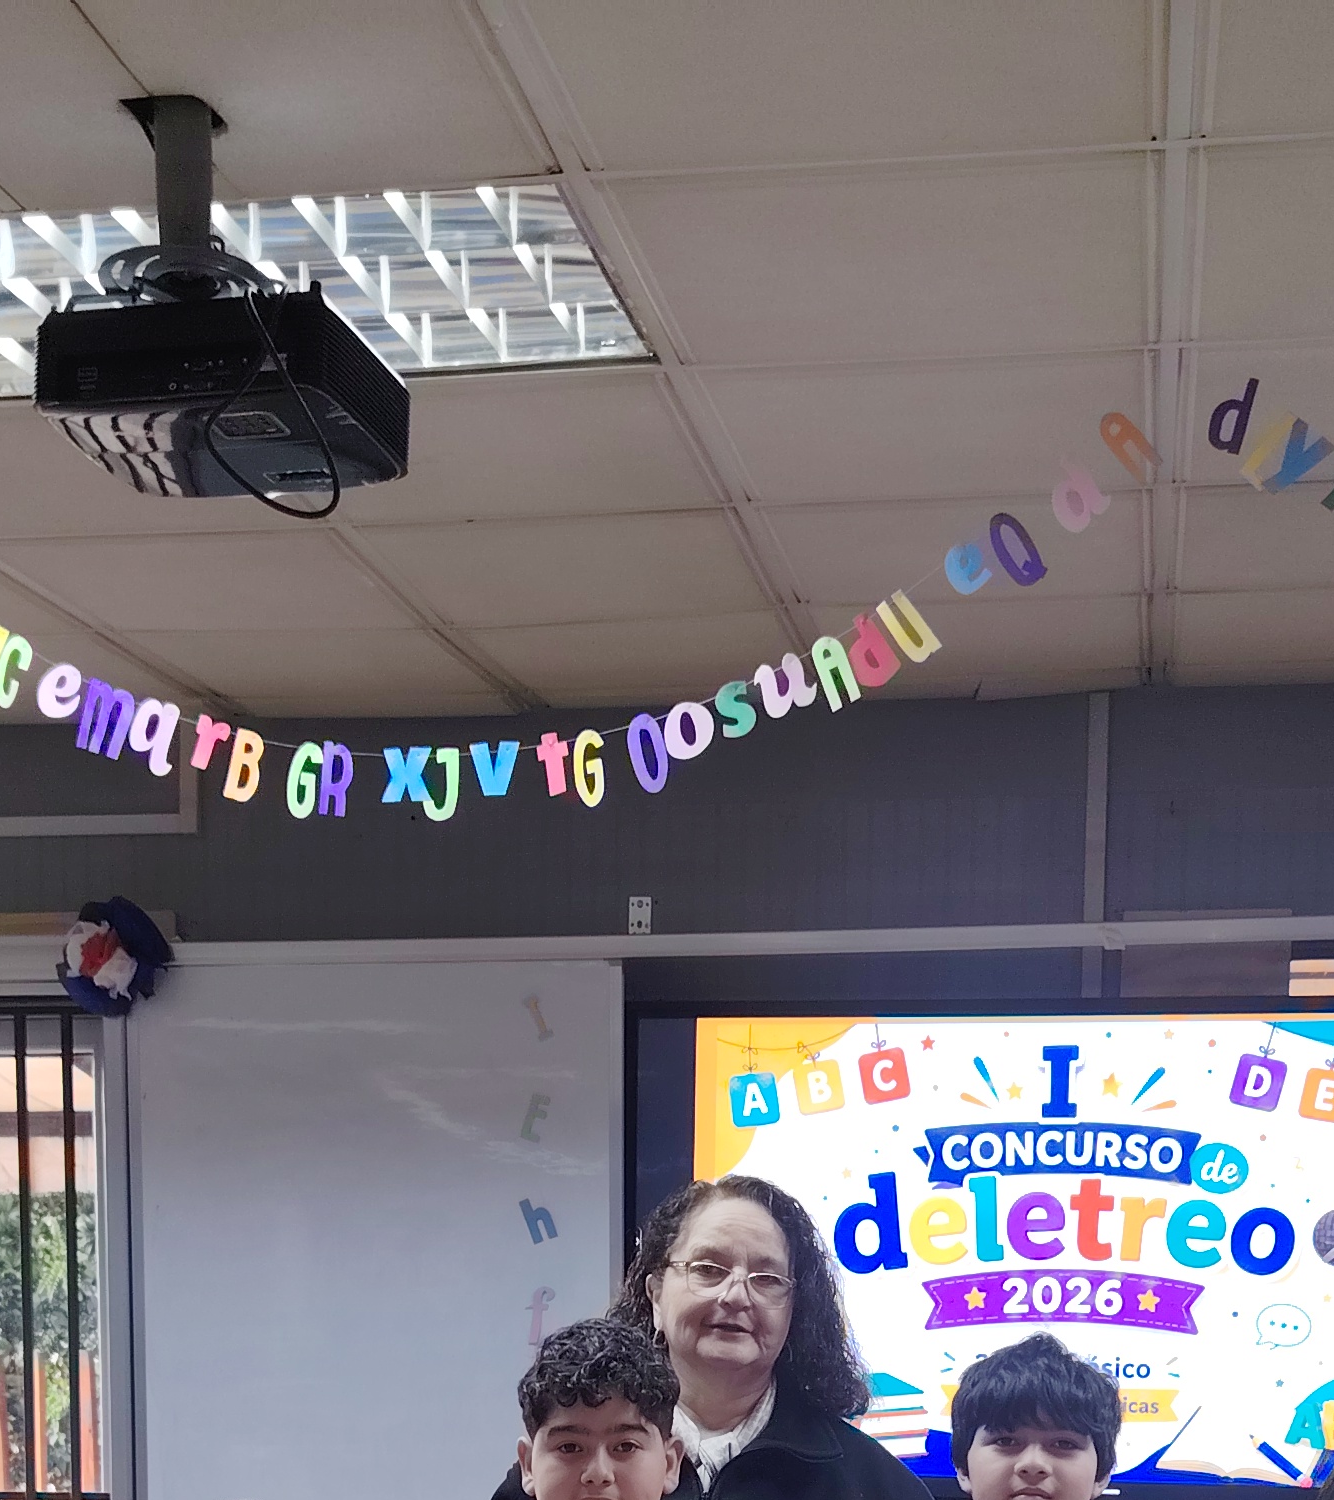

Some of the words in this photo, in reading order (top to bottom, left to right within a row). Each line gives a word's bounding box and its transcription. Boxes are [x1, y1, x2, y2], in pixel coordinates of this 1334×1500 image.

[741, 1084, 768, 1117] A
[807, 1070, 833, 1106] B
[872, 1057, 898, 1093] C
[1041, 1044, 1080, 1120] I
[1244, 1064, 1271, 1100] D
[941, 1129, 1184, 1176] CONCURSO
[1200, 1150, 1240, 1184] de
[519, 1198, 558, 1245] h
[833, 1171, 1295, 1275] deletreo
[1001, 1275, 1124, 1317] 2026
